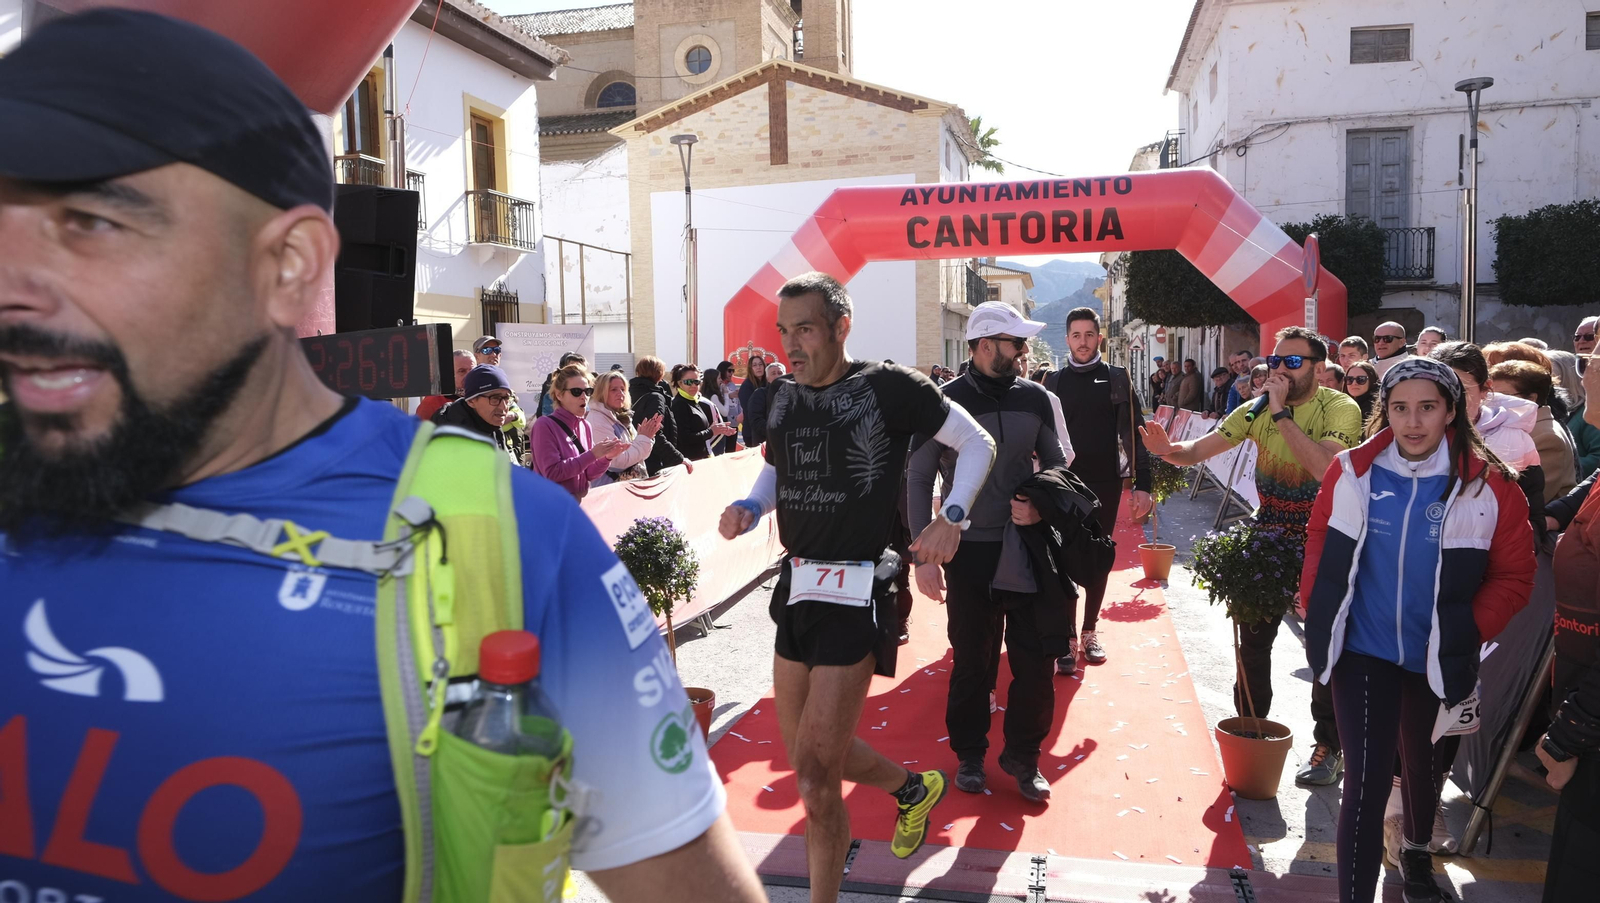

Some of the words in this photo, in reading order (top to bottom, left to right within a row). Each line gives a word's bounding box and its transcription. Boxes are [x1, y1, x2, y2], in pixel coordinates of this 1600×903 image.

[900, 176, 1133, 206] AYUNTAMIENTO
[906, 207, 1125, 249] CANTORIA
[795, 427, 812, 438] LIFE
[812, 427, 820, 437] IS
[791, 441, 823, 466] Trail
[795, 471, 803, 480] IS
[804, 470, 818, 481] LIFE
[804, 484, 847, 504] Extreme
[816, 568, 845, 588] 71
